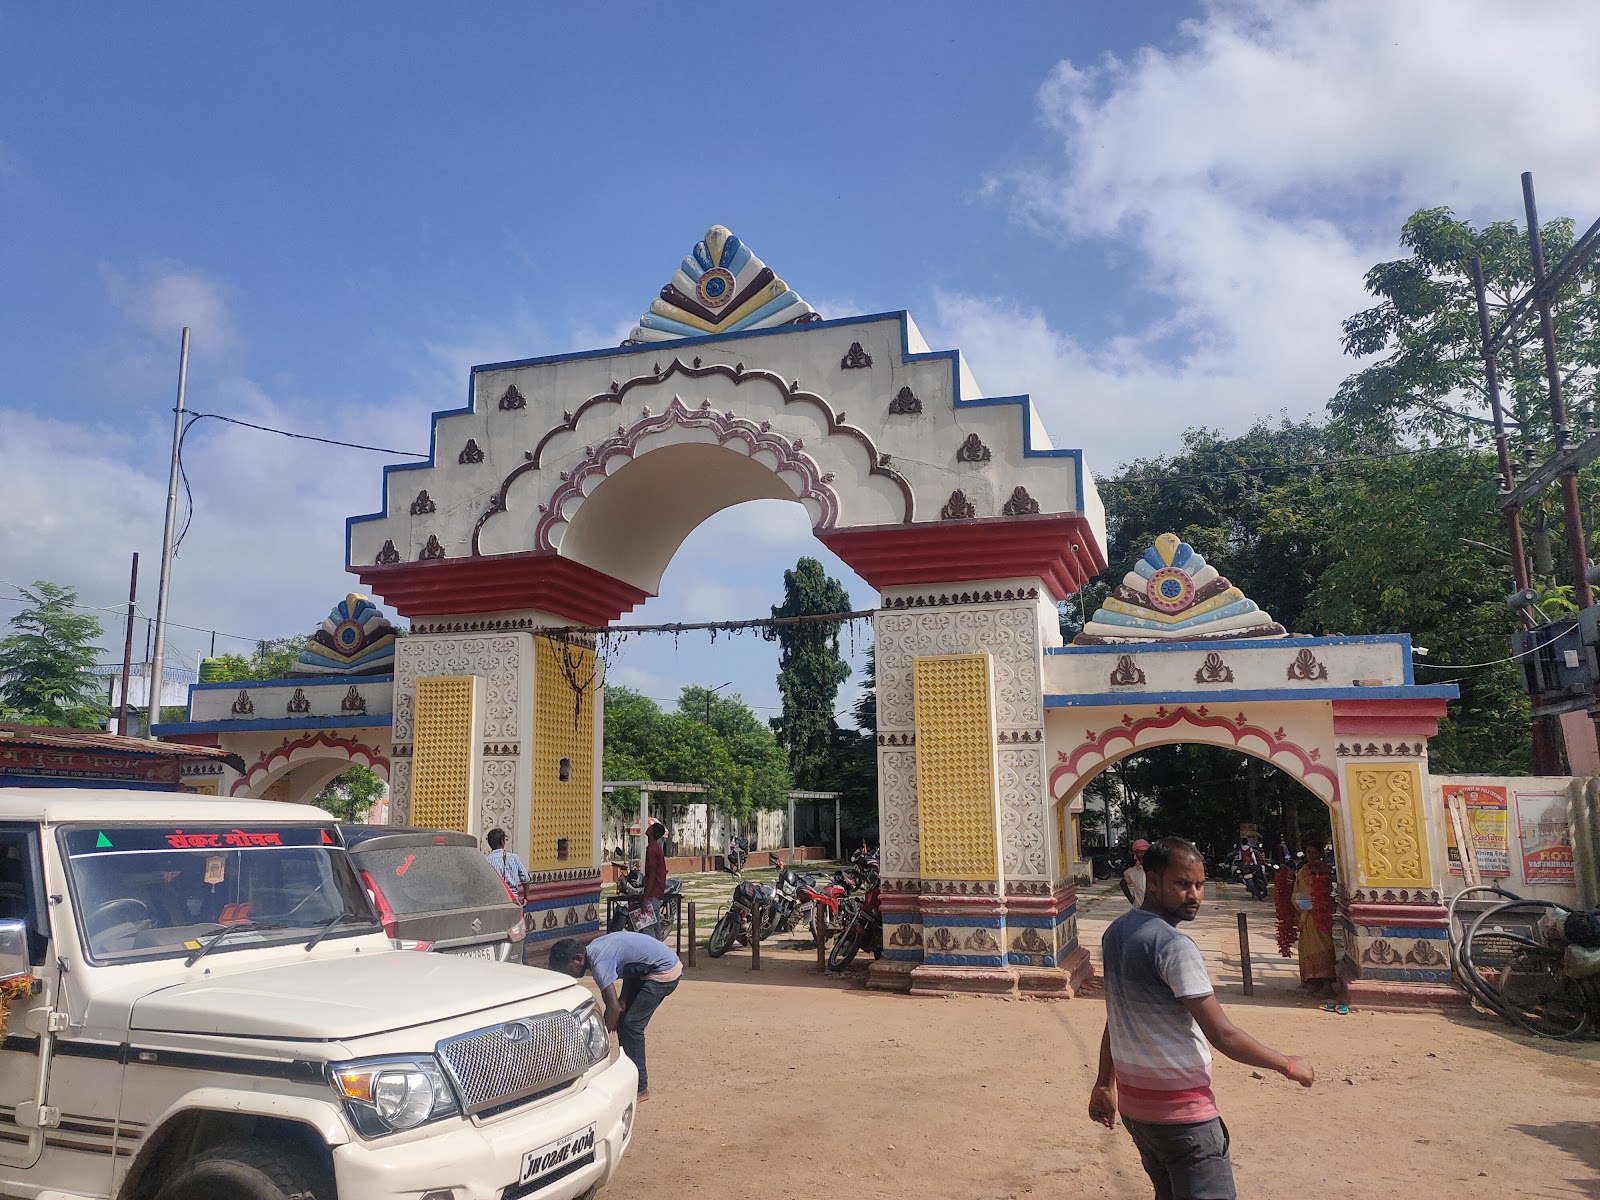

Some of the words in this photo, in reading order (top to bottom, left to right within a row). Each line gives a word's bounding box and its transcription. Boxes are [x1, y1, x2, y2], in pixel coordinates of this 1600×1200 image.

[165, 829, 222, 848] संकट
[223, 829, 283, 846] मोचन
[1540, 851, 1571, 861] HOT
